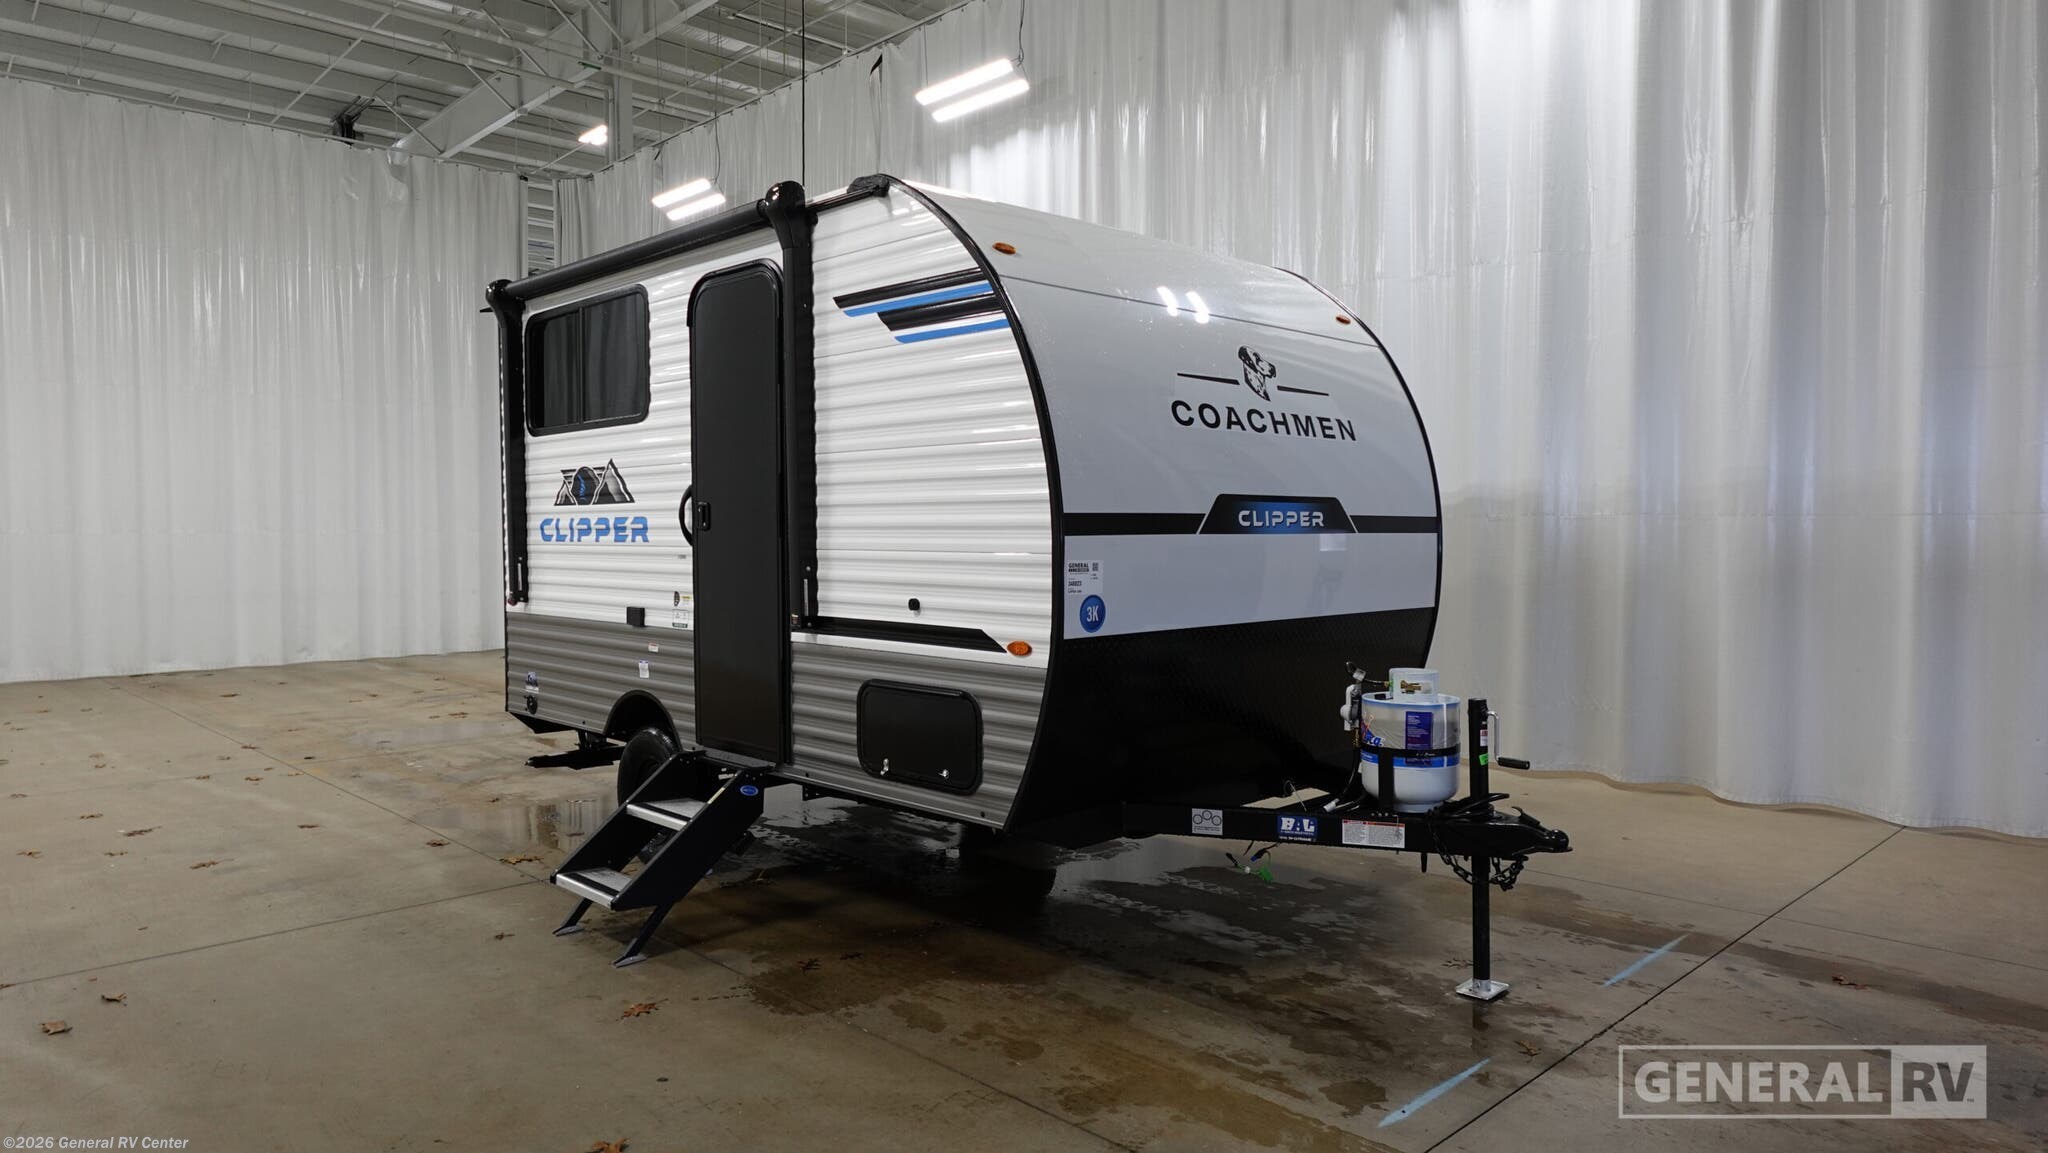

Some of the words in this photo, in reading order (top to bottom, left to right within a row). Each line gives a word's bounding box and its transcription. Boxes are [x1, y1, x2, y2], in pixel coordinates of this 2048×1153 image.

[1171, 400, 1357, 442] COACHMEN
[539, 516, 649, 543] CLIPPER
[1238, 509, 1324, 528] CLIPPER
[1086, 605, 1099, 622] 3K
